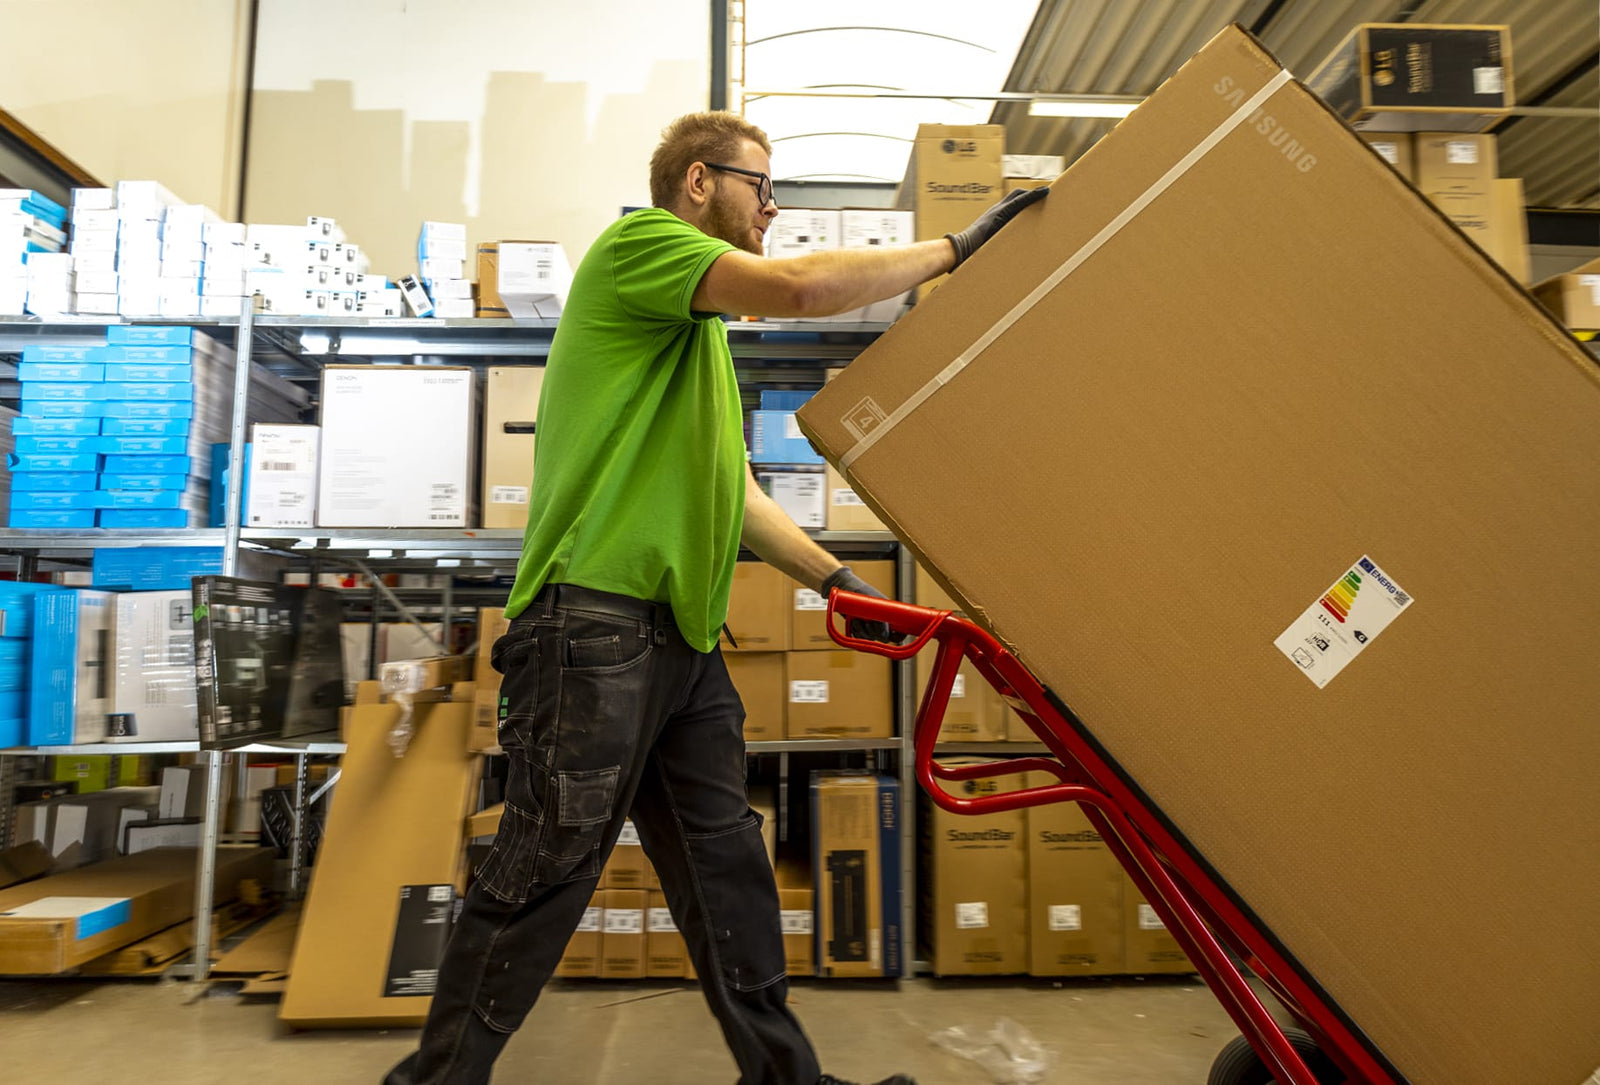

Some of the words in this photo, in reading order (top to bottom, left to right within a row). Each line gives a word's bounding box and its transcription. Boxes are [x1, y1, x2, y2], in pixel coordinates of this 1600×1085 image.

[957, 141, 977, 152] LG
[926, 181, 994, 194] SoundBar
[980, 780, 998, 792] LG
[946, 829, 1016, 842] SoundBar
[1039, 830, 1105, 843] SoundBa
